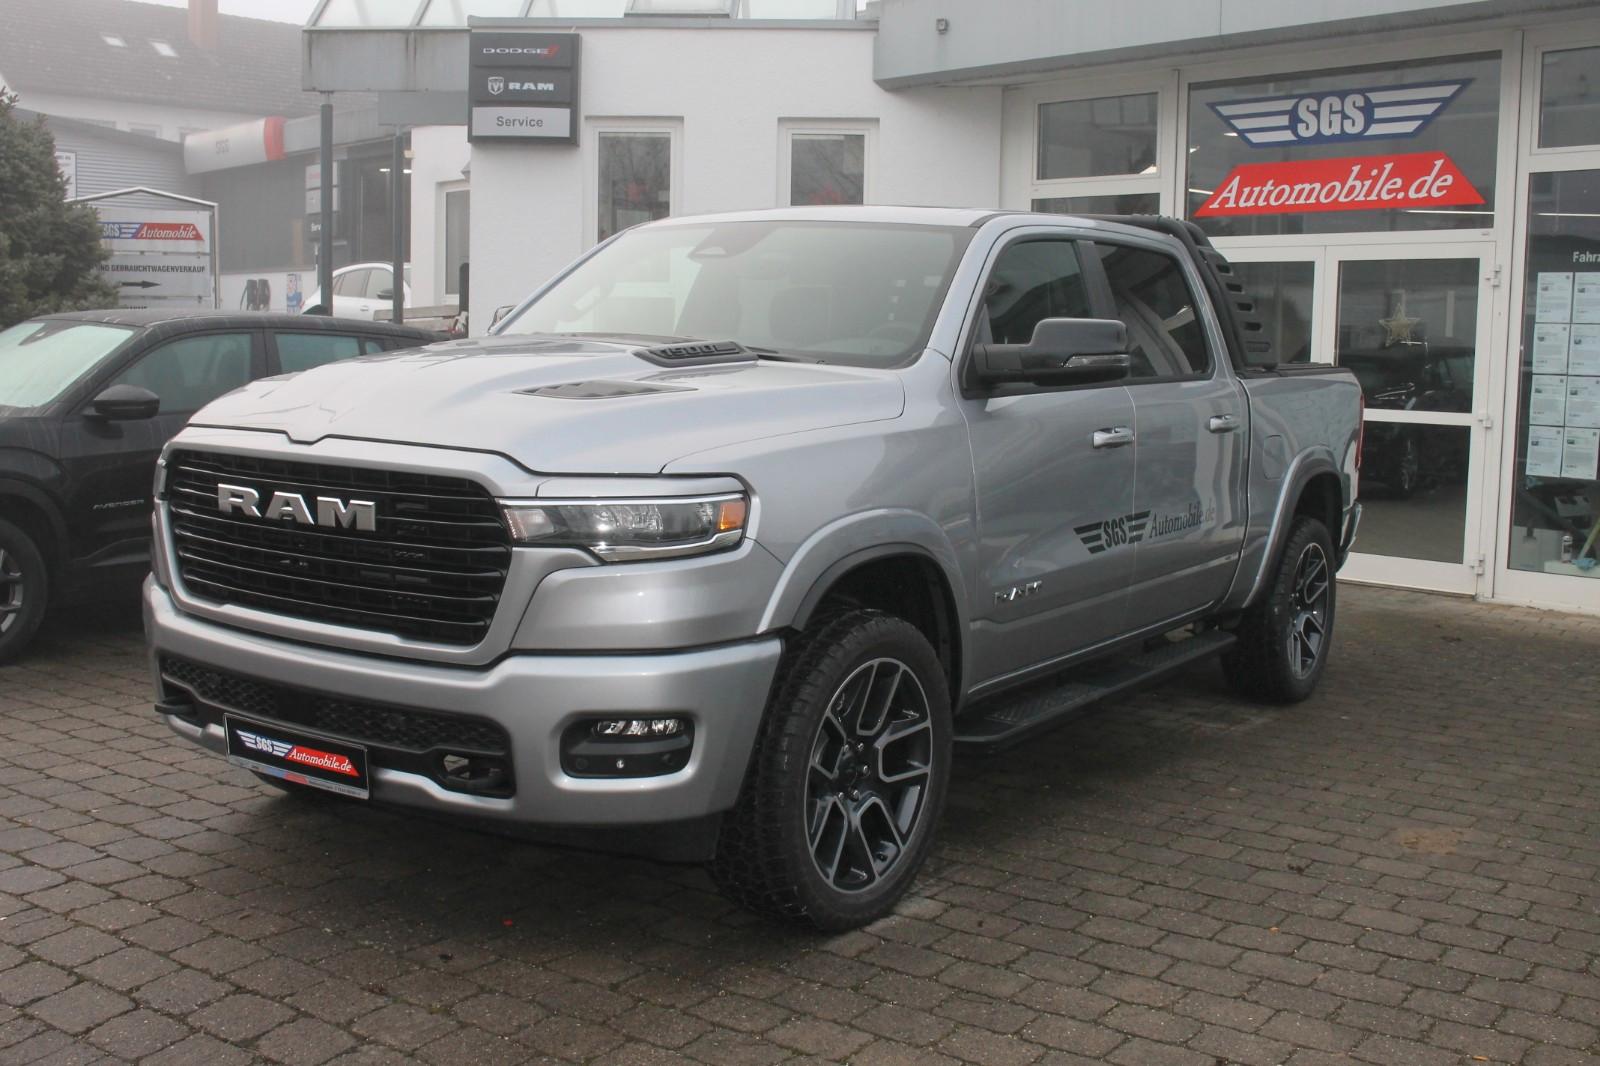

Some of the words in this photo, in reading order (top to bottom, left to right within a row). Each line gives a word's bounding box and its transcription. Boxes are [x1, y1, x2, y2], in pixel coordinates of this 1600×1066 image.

[482, 47, 551, 55] DODGE
[508, 82, 554, 91] RAM
[496, 115, 544, 128] Service
[1297, 93, 1365, 138] SGS
[1209, 159, 1454, 209] Automobile.de
[138, 224, 197, 238] Automobile
[217, 483, 376, 532] RAM
[1103, 517, 1127, 549] SGS
[256, 736, 273, 753] SGS
[289, 748, 352, 773] Automobile.de
